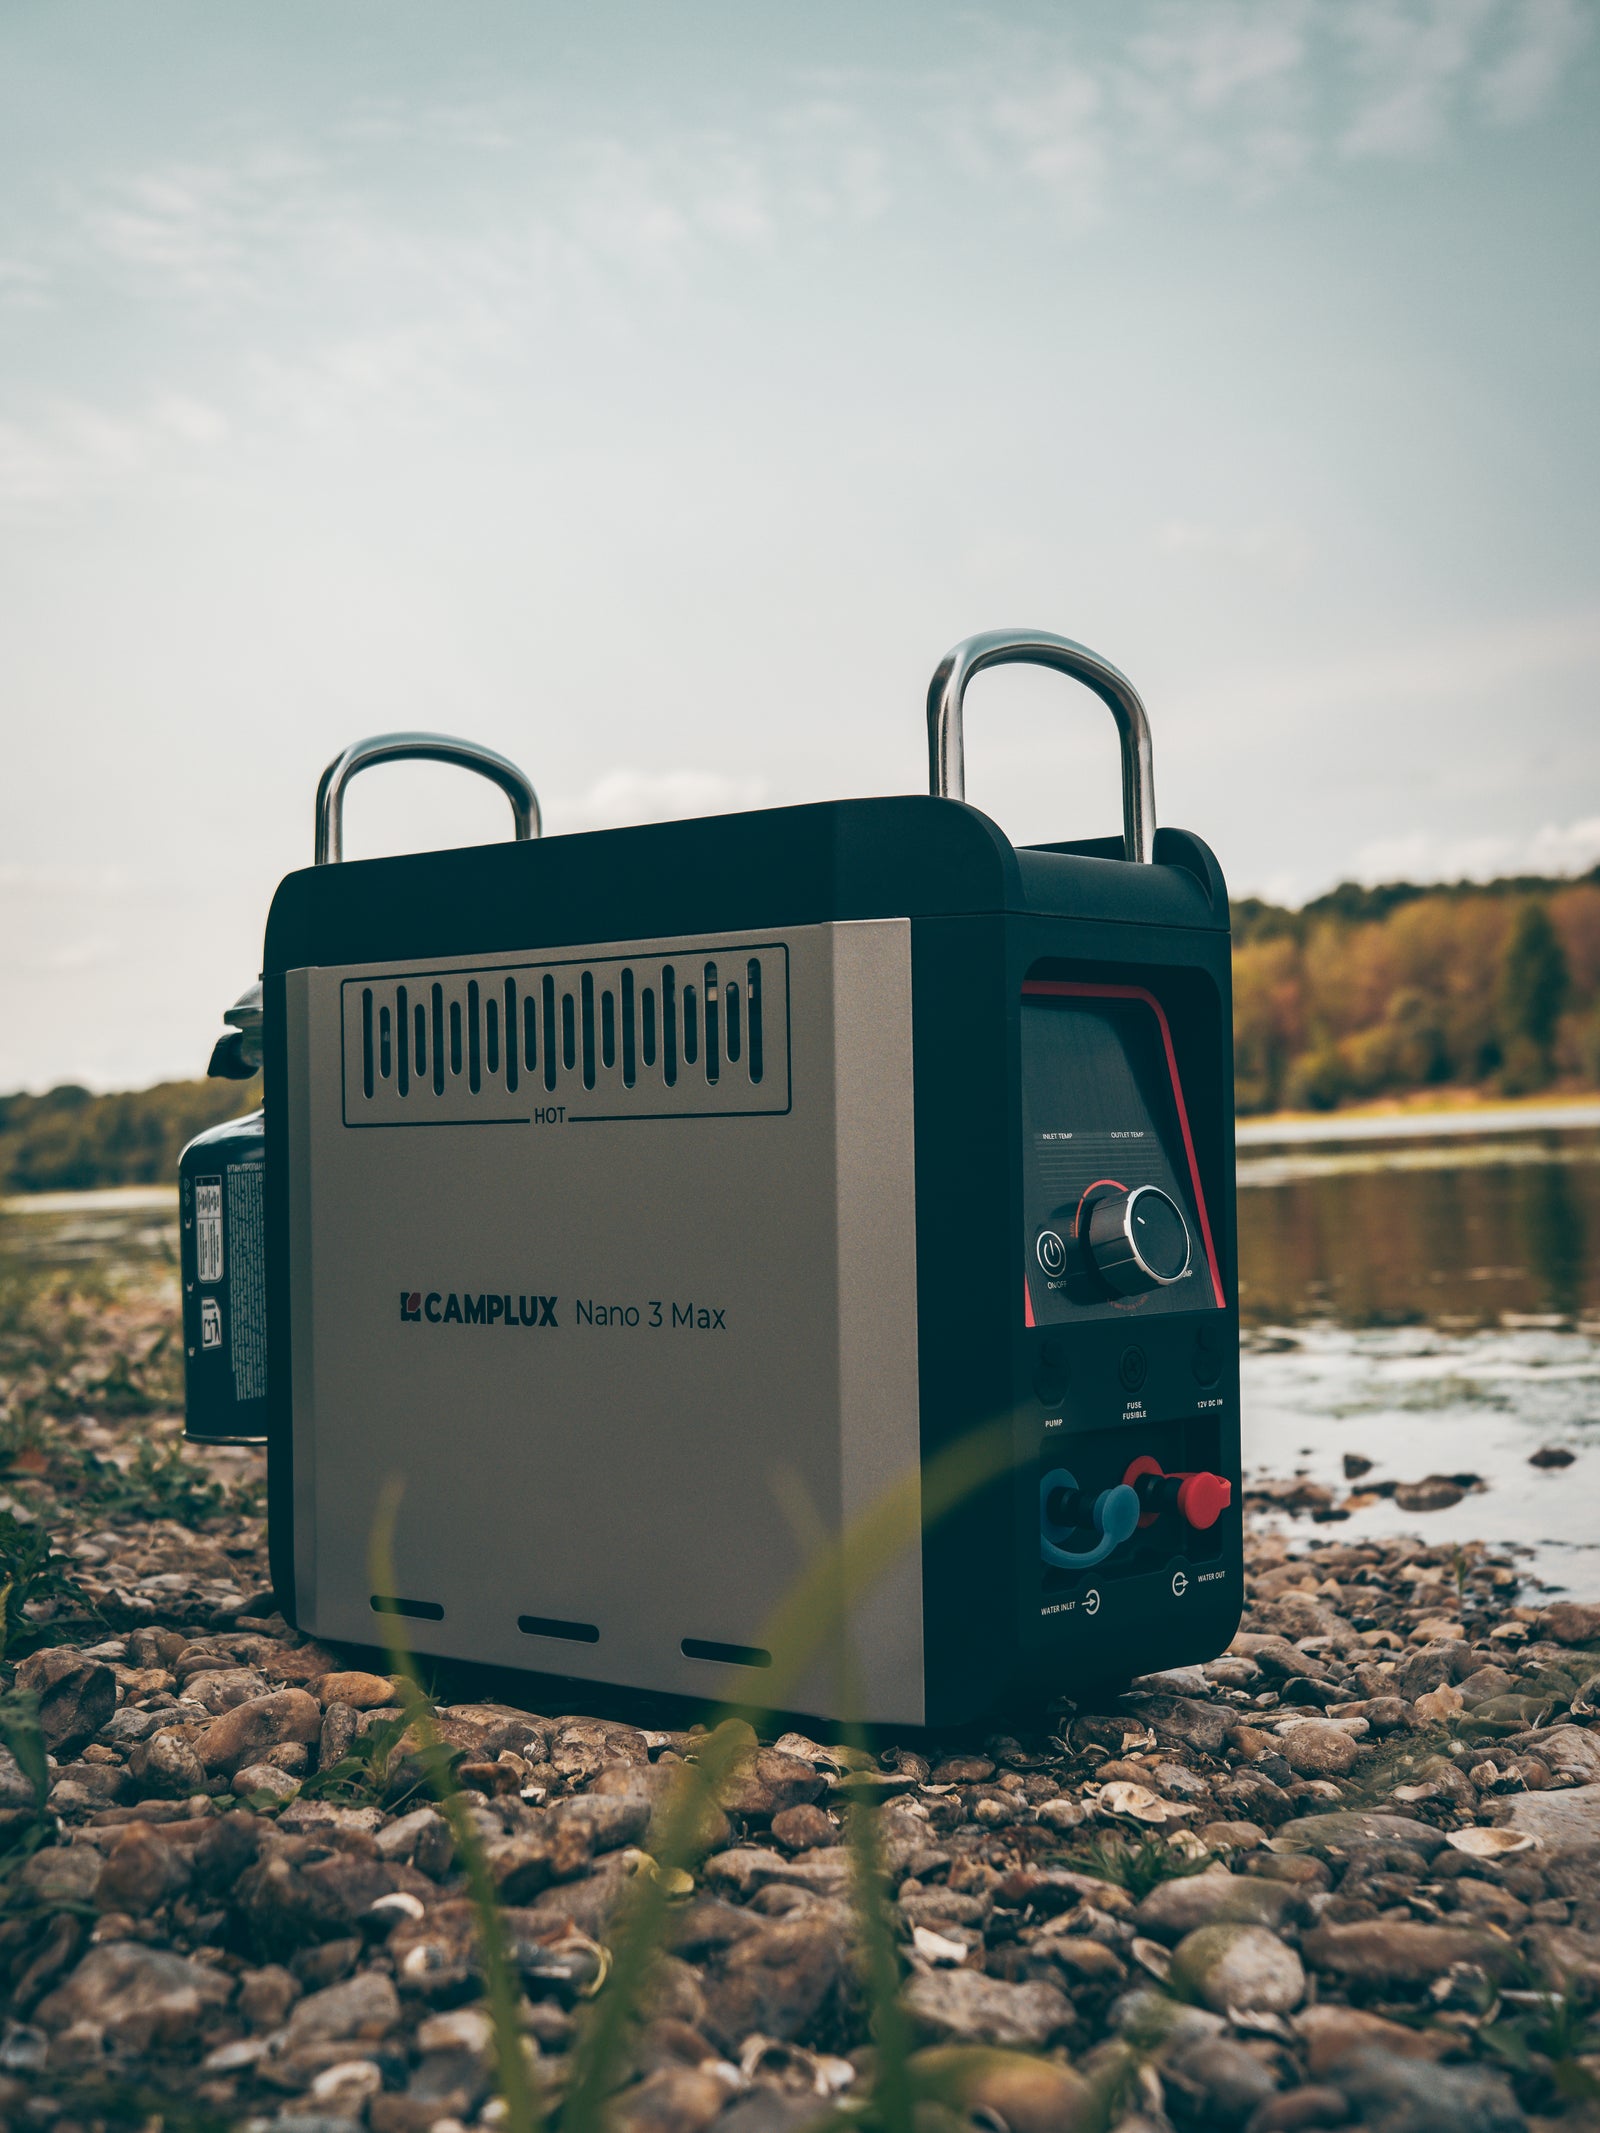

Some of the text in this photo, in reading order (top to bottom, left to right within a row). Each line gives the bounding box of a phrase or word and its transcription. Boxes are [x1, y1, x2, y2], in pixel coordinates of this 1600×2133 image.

[534, 1106, 566, 1124] HOT
[1058, 1132, 1073, 1140] TEMP
[1110, 1131, 1145, 1139] OUTLET TEMP
[1047, 1280, 1067, 1289] ON/OFF
[424, 1292, 727, 1330] CAMPLUX Nano 3 Max
[1126, 1401, 1142, 1410] FUSE
[1197, 1398, 1223, 1409] 12V DC IN
[1122, 1410, 1147, 1420] FUSIBLE
[1045, 1418, 1063, 1428] PUMP
[1197, 1570, 1225, 1583] WATER OUT
[1041, 1600, 1076, 1616] WATER INLET
